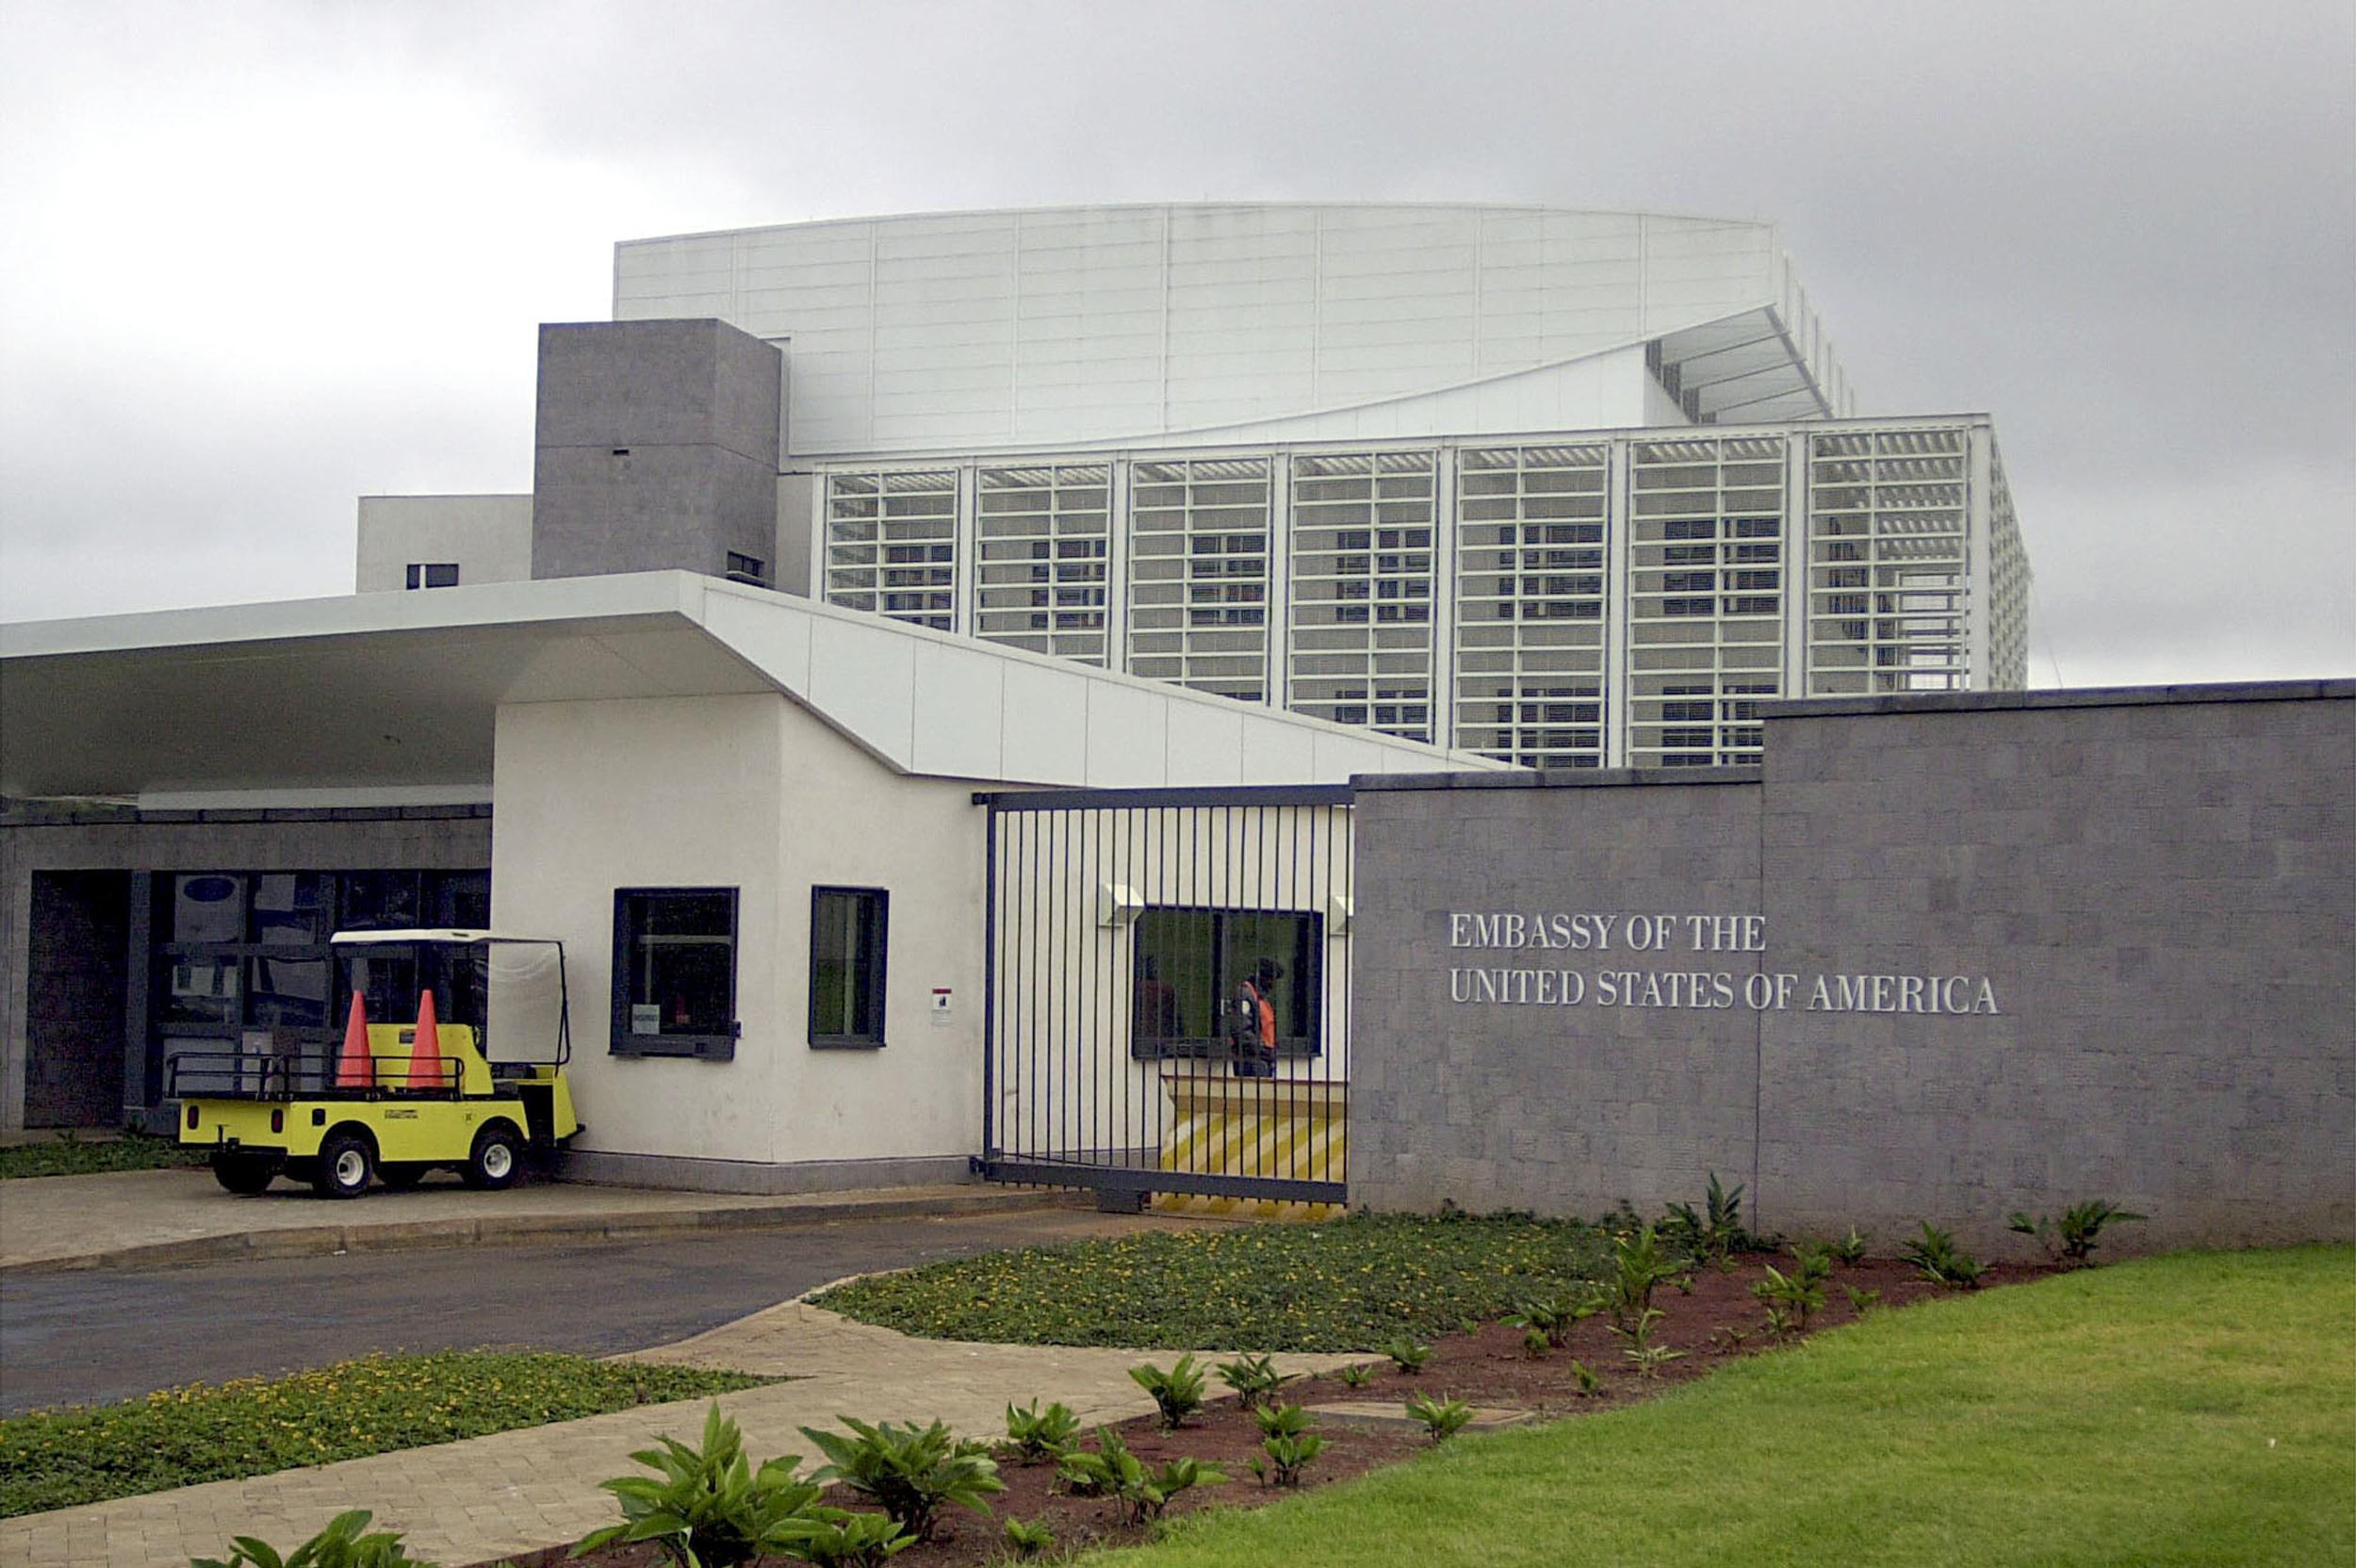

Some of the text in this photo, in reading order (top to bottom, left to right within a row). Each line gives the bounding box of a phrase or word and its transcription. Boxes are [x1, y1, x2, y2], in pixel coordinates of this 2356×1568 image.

[1449, 913, 1766, 952] EMBASSY OF THE
[1449, 968, 2001, 1015] UNITED STATES OF AMERICA
